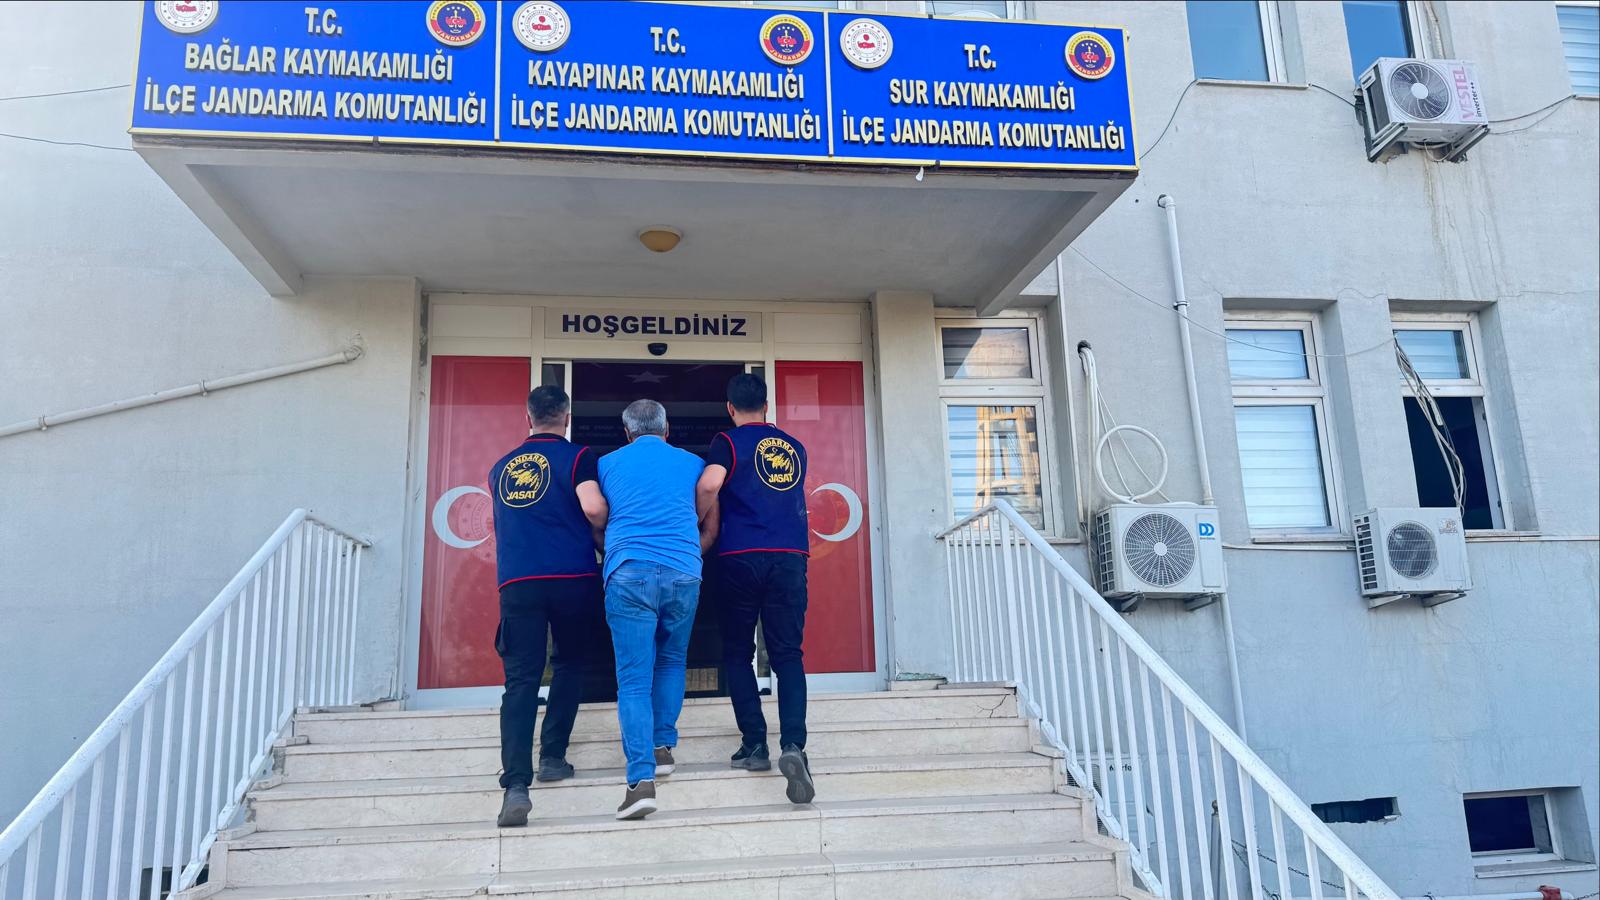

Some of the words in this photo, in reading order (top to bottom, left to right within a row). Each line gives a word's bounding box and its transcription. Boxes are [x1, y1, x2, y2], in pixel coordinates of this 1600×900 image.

[304, 7, 343, 34] T.C.
[436, 29, 476, 42] JANDARMA
[650, 26, 686, 54] T.C.
[184, 37, 277, 73] BAĞLAR
[283, 48, 453, 81] KAYMAKAMLIĞI
[770, 49, 806, 61] JANDARMA
[964, 43, 997, 69] T.C.
[528, 59, 646, 91] KAYAPINAR
[651, 66, 804, 99] KAYMAKAMLIĞI
[1452, 66, 1475, 119] VESTEL
[143, 76, 196, 115] İLÇE
[201, 86, 328, 119] JANDARMA
[334, 91, 486, 124] KOMUTANLIĞI
[889, 78, 929, 105] SUR
[933, 80, 1076, 111] KAYMAKAMLIĞI
[511, 93, 559, 129] İLÇE
[564, 102, 678, 134] JANDARMA
[684, 108, 821, 141] KOMUTANLIĞI
[842, 109, 886, 145] İLÇE
[890, 118, 995, 147] JANDARMA
[998, 120, 1126, 150] KOMUTANLIĞI
[562, 313, 747, 338] HOŞGELDİNİZ
[757, 438, 795, 457] JANDARMA
[506, 454, 549, 474] JANDARMA
[768, 473, 793, 483] JASAT
[506, 490, 537, 501] JASAT
